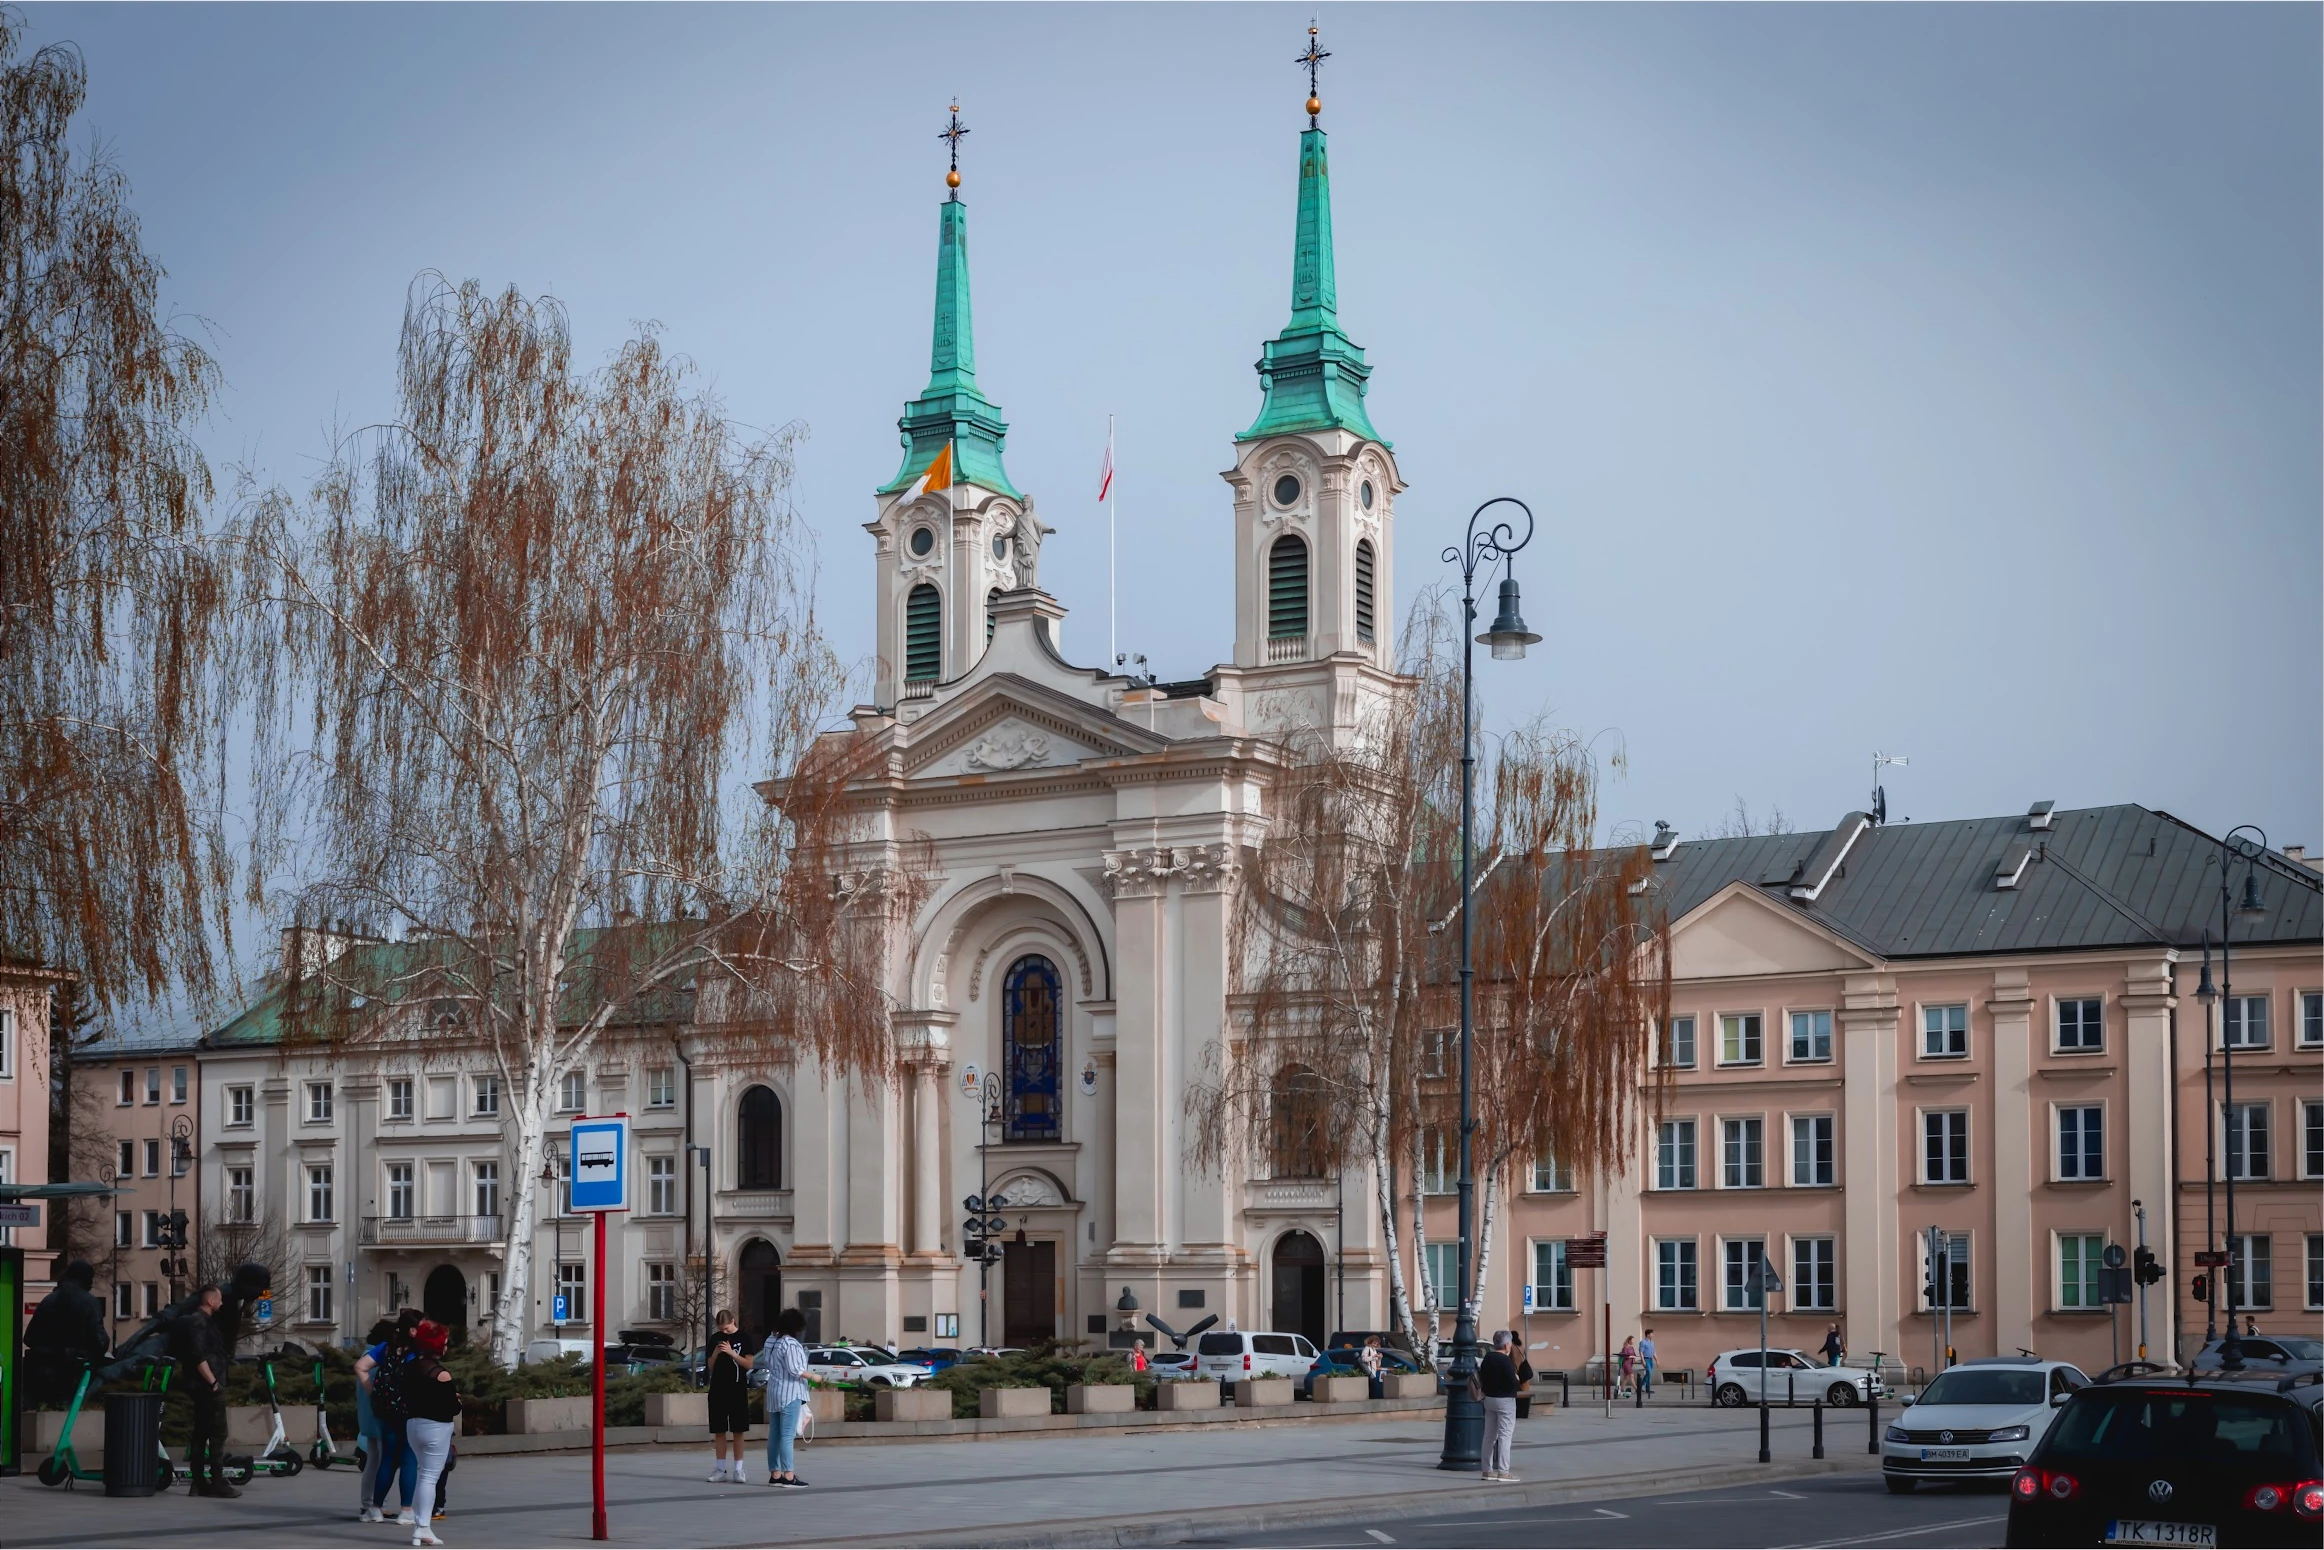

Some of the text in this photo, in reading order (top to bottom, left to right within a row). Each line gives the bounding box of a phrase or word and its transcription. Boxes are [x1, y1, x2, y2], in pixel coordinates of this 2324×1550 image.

[19, 1212, 30, 1221] 02
[556, 1297, 564, 1313] P
[1956, 1450, 1968, 1459] EA
[2119, 1521, 2213, 1545] TK 1318R
